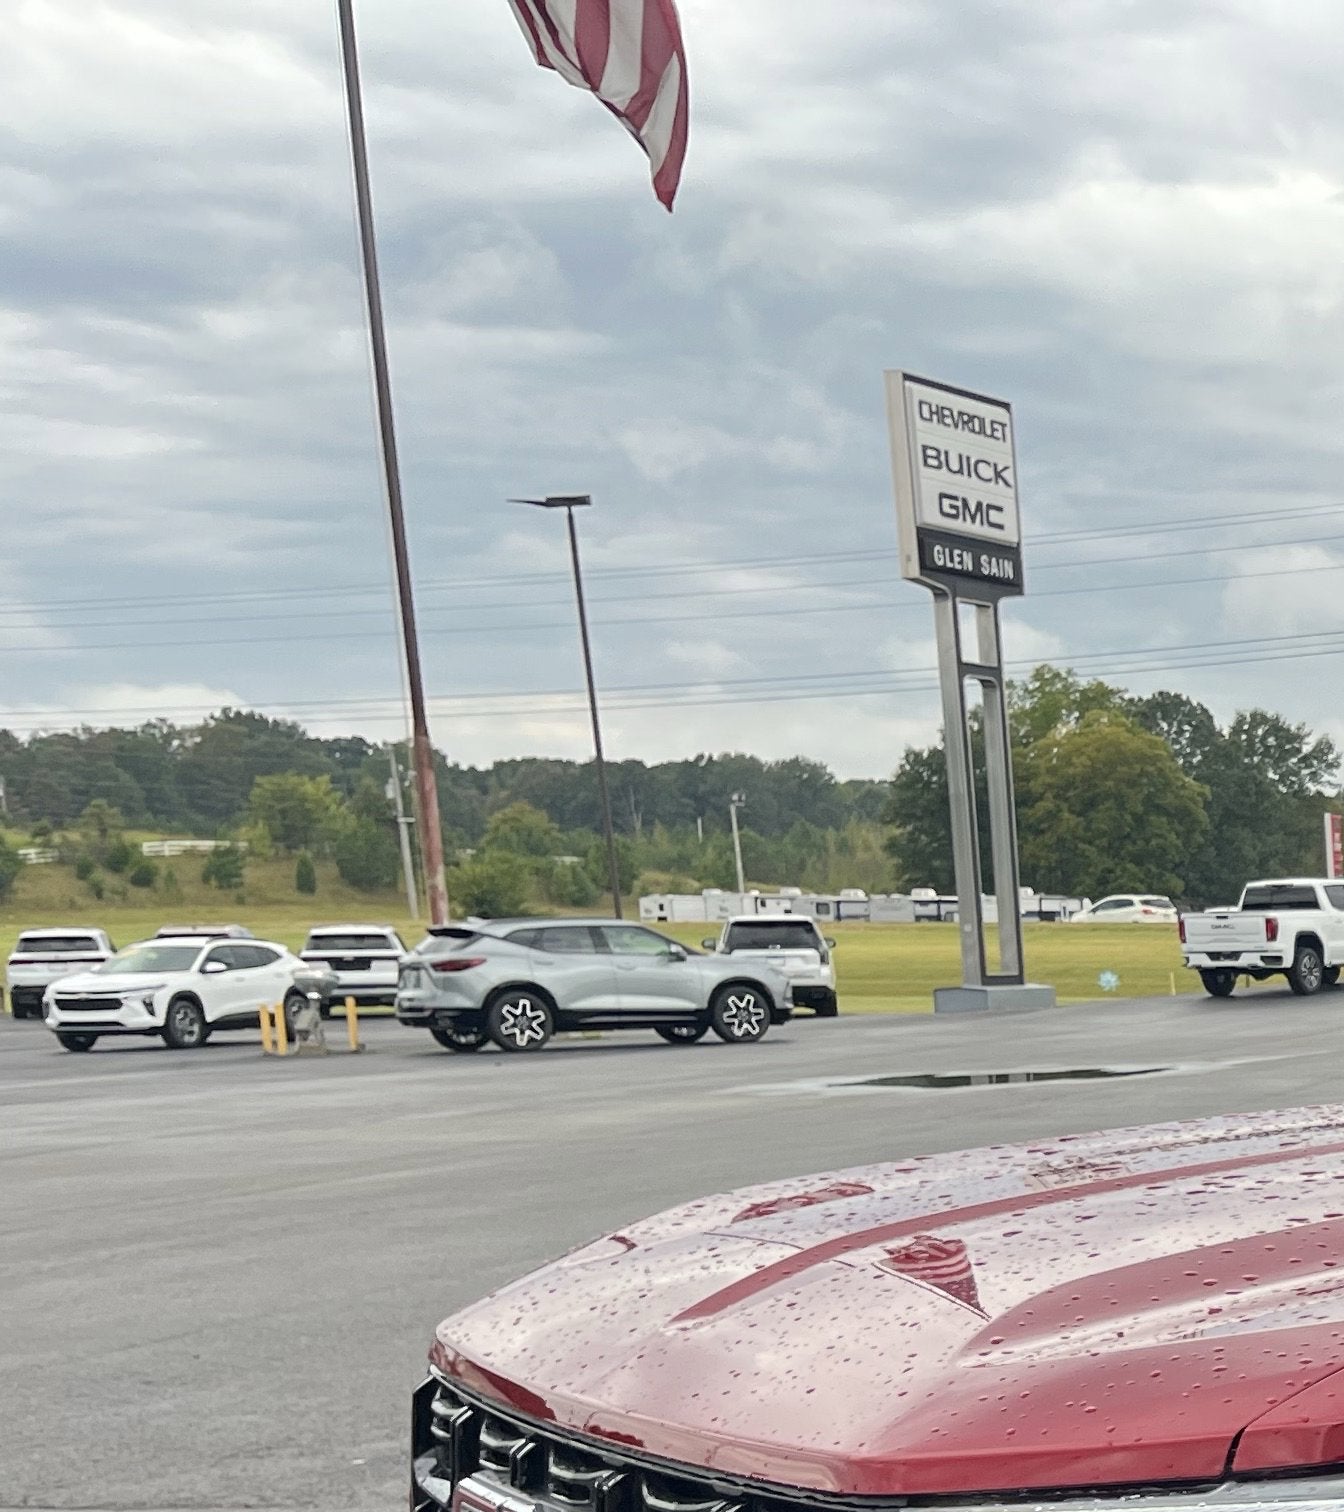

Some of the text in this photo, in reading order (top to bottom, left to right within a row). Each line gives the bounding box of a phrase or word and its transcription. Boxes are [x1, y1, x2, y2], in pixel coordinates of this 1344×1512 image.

[918, 399, 1007, 443] CHEVROLET
[921, 444, 1012, 488] BUICK
[938, 492, 1005, 530] GMC
[933, 544, 1015, 580] GLEN SAIN
